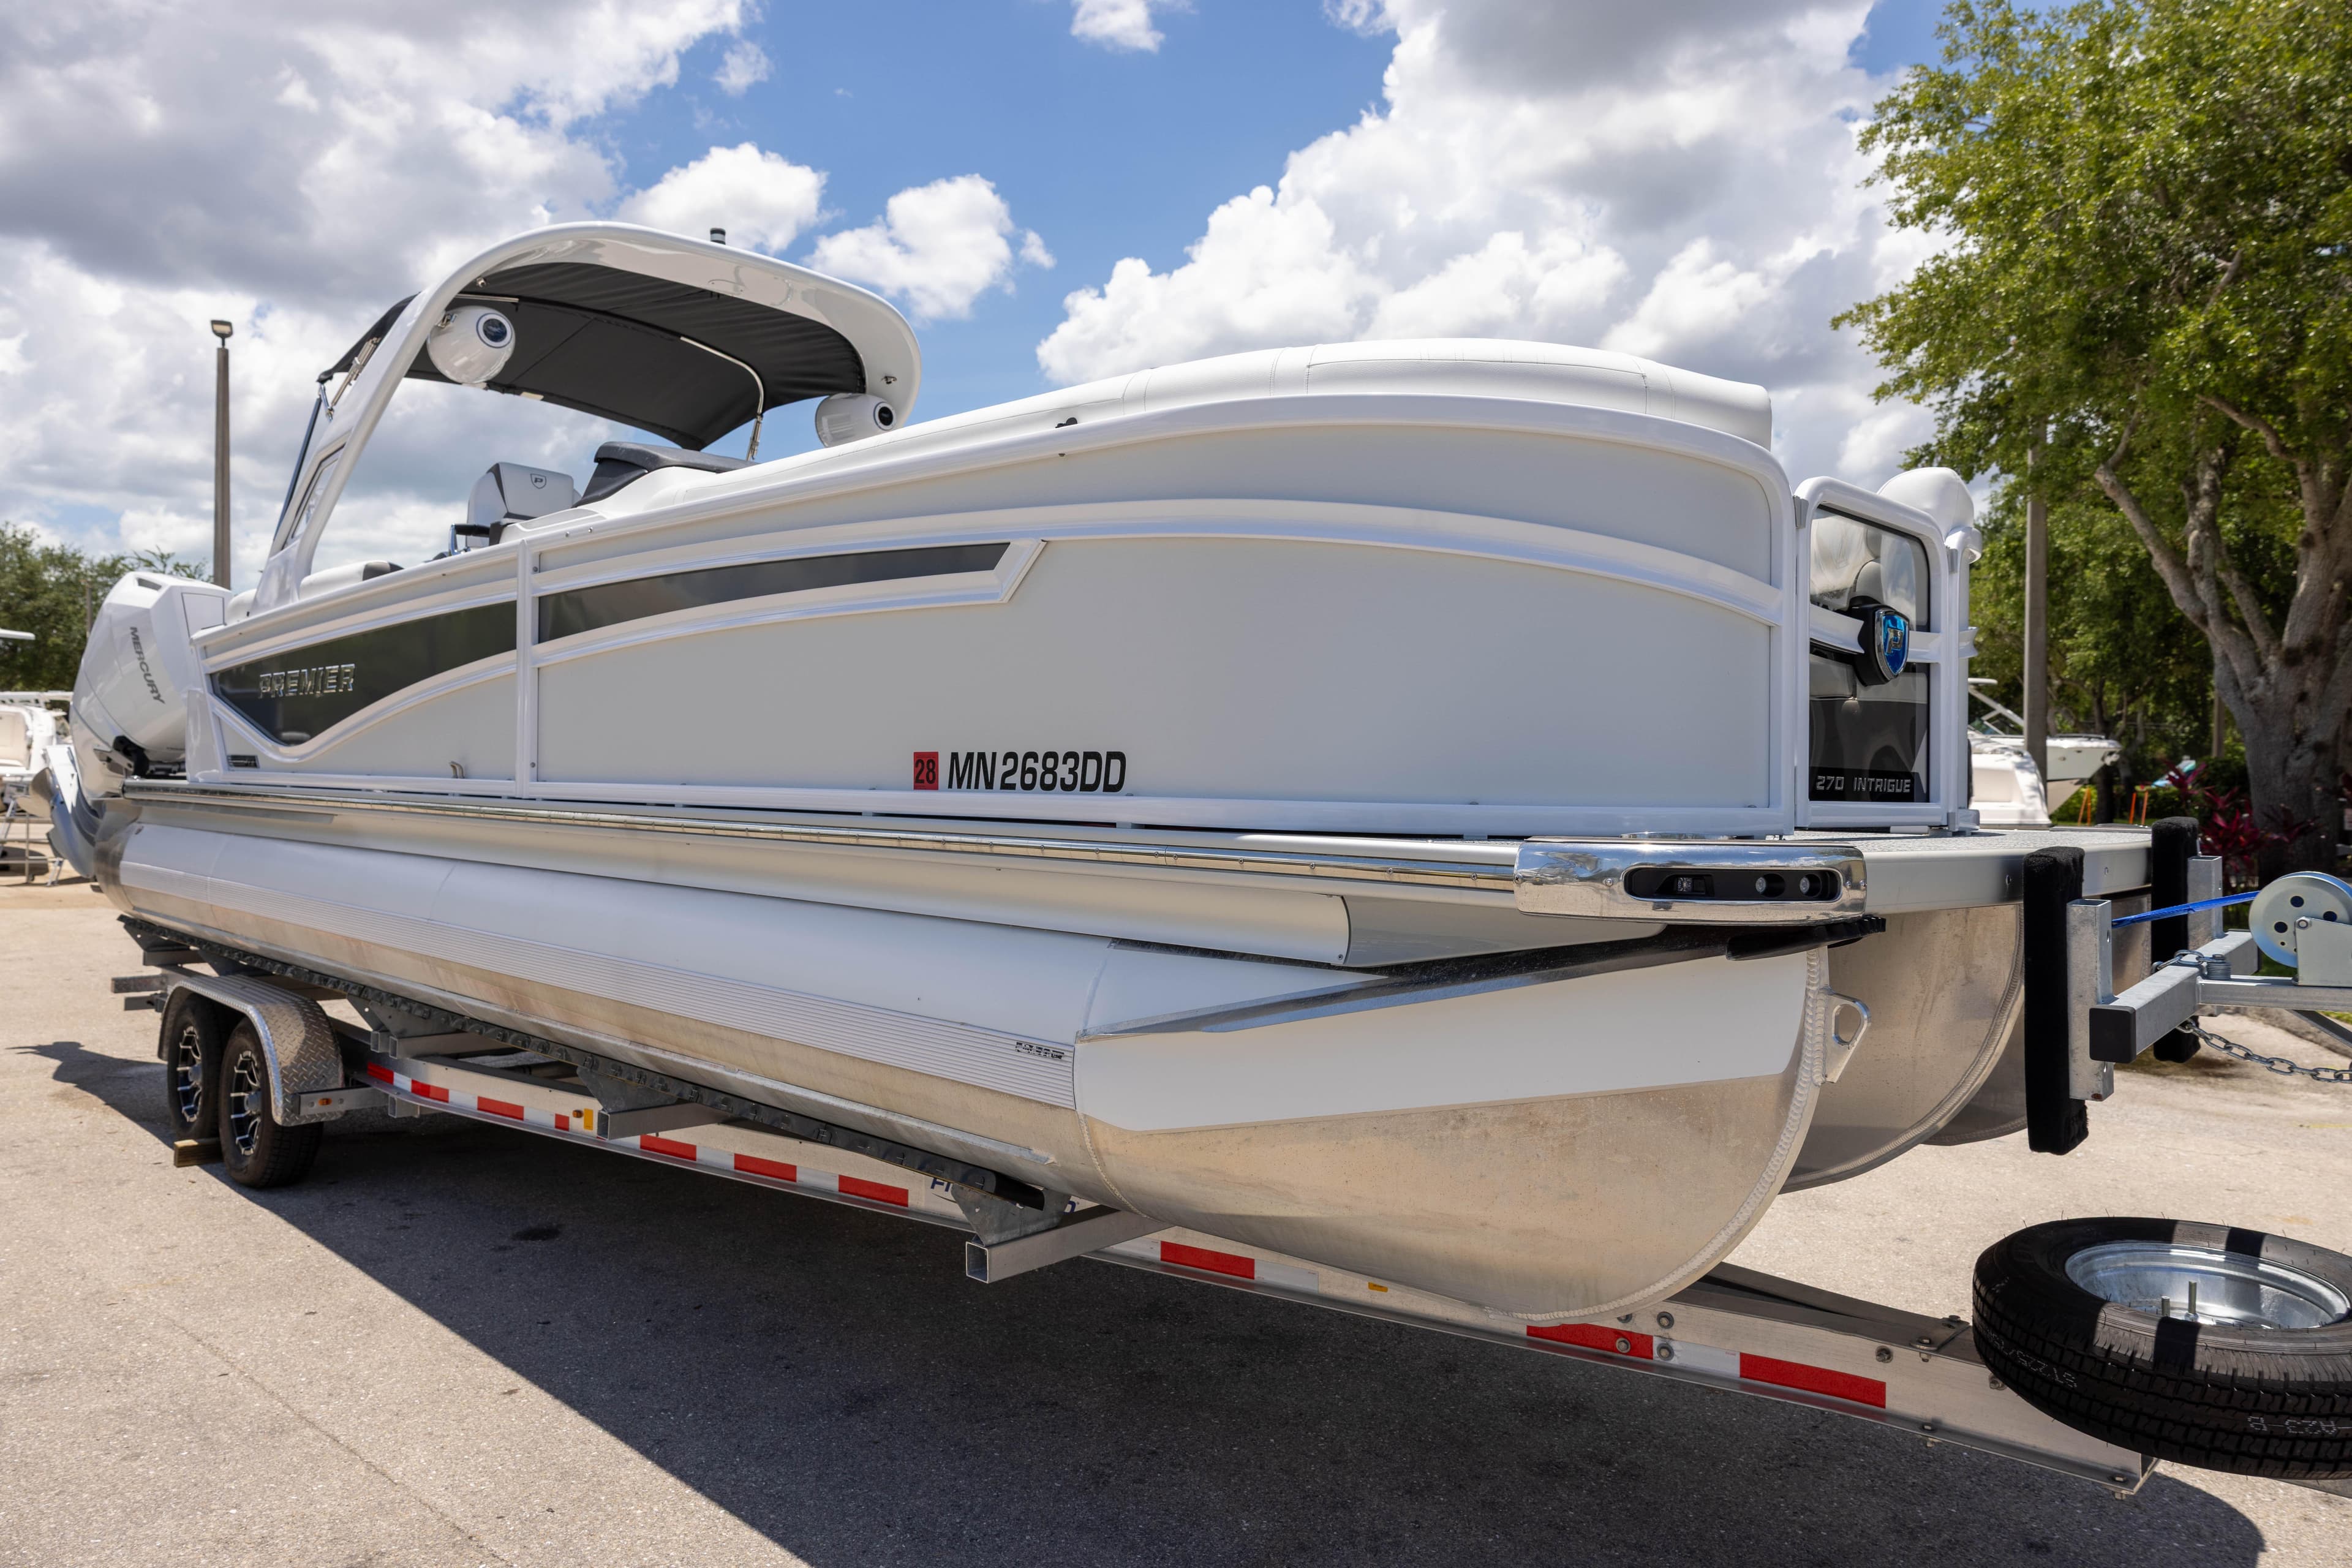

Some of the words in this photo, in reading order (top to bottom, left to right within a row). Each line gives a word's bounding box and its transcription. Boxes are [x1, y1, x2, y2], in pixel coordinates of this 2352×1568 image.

[130, 627, 165, 704] MERCURY
[258, 663, 355, 699] PREMIER
[915, 759, 936, 784] 28
[1815, 775, 1844, 791] 270
[1853, 777, 1911, 793] INTRIGUE
